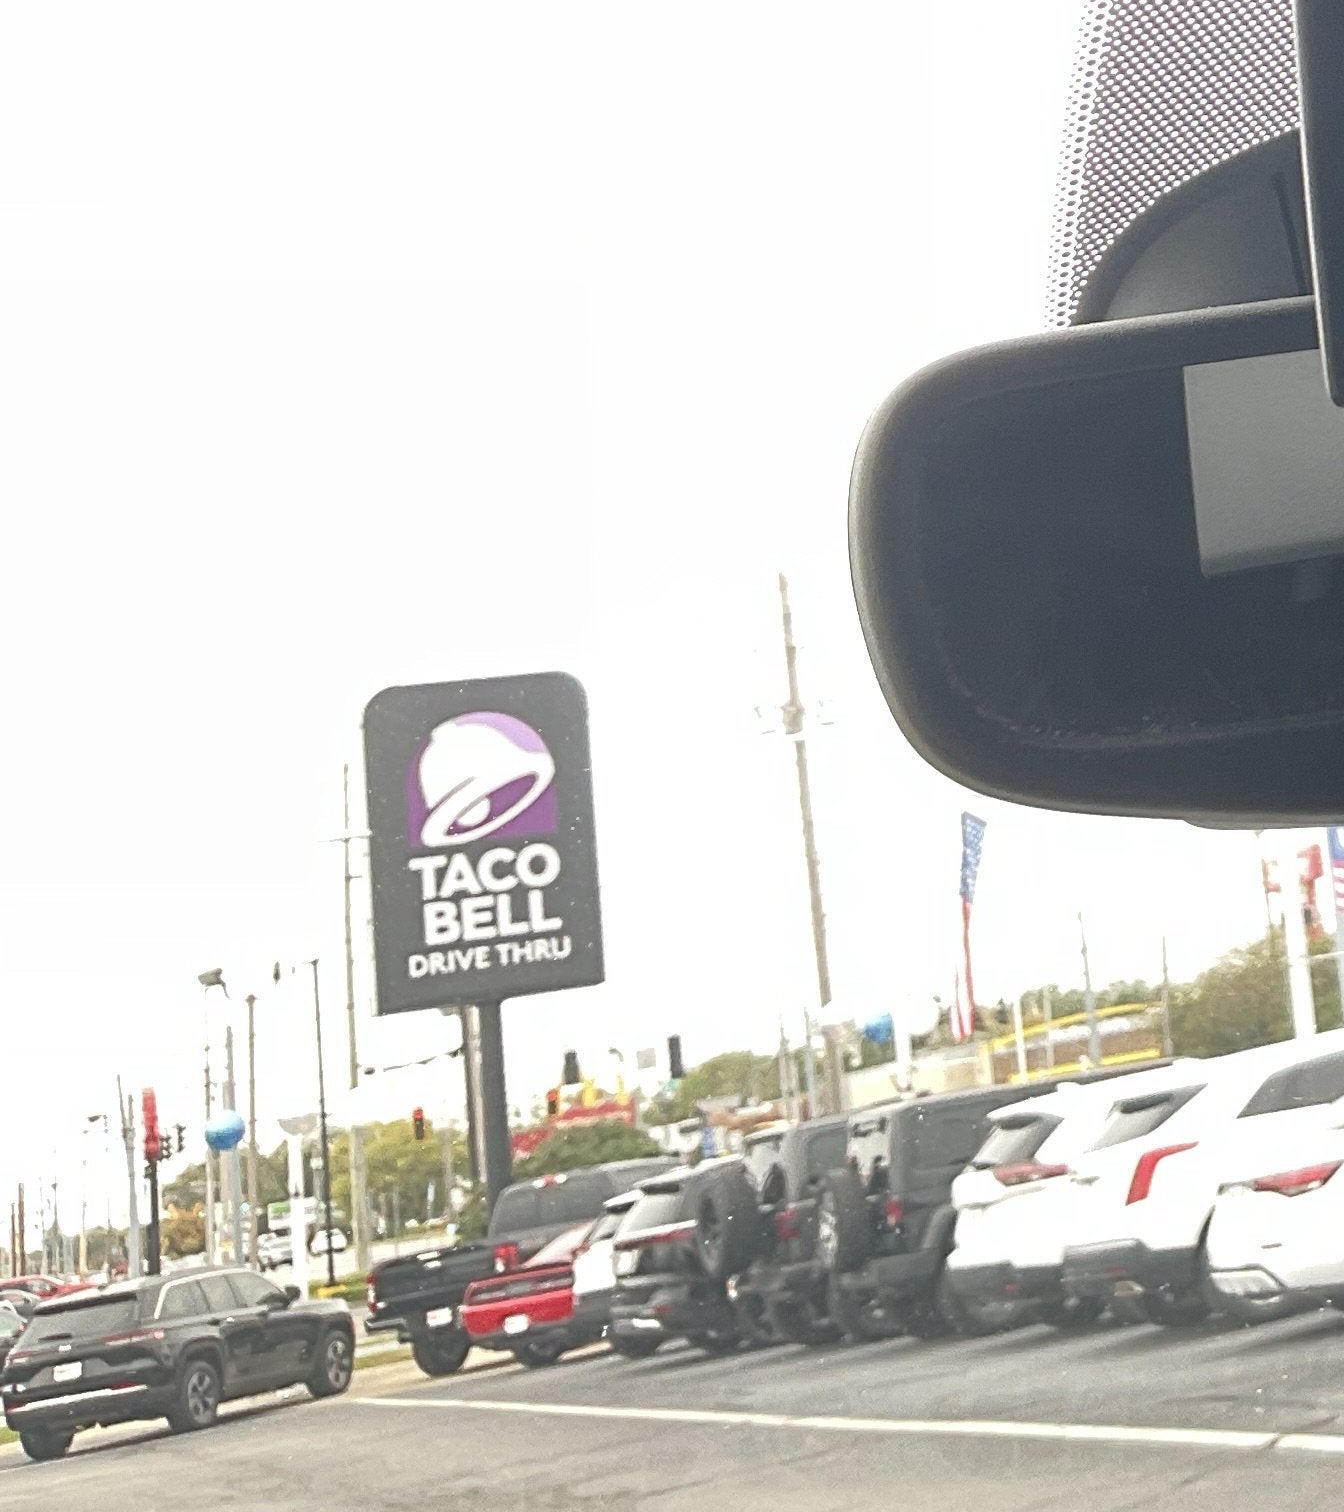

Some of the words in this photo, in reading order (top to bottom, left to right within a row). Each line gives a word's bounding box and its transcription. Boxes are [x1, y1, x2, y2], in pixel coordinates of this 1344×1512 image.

[408, 842, 561, 901] TACO
[423, 889, 562, 947] BELL
[408, 944, 490, 979] DRIVE
[495, 935, 572, 967] THRU
